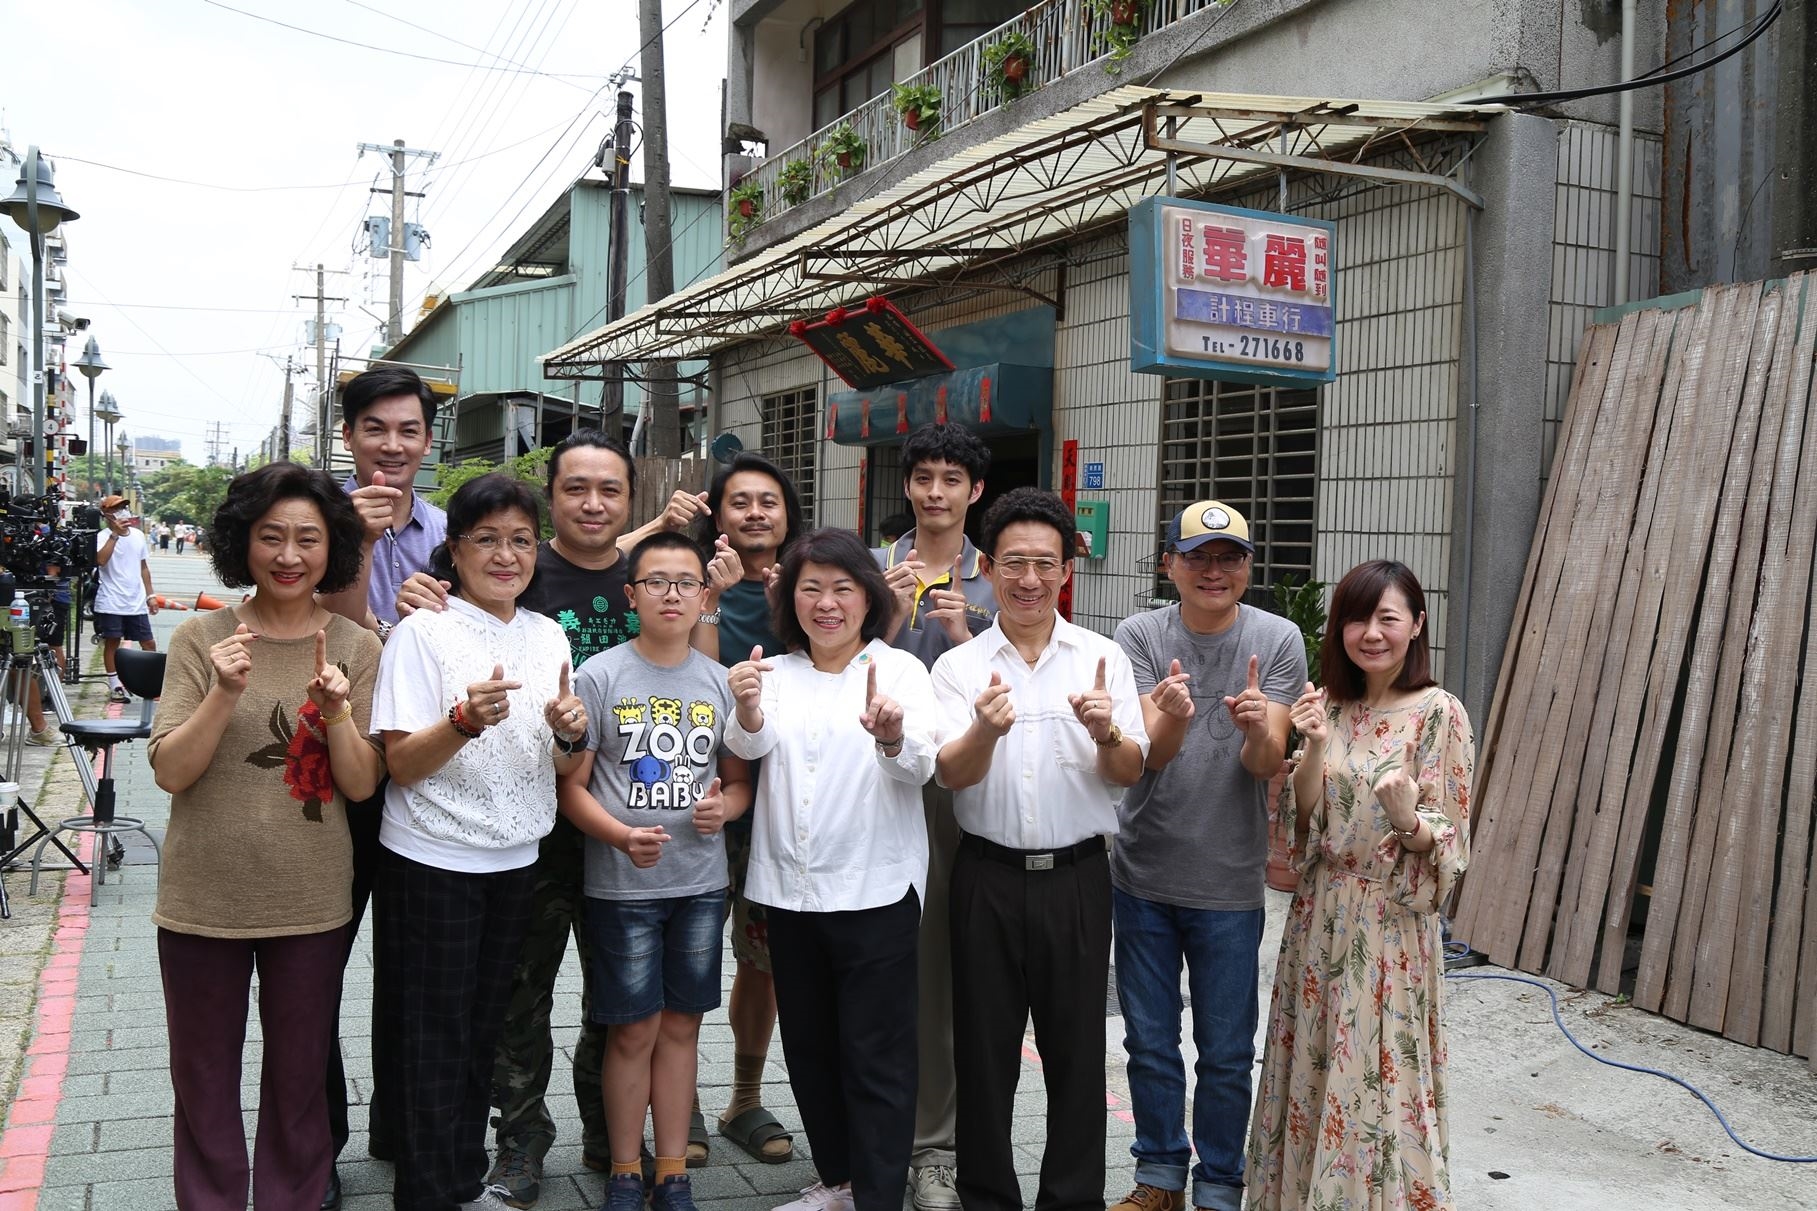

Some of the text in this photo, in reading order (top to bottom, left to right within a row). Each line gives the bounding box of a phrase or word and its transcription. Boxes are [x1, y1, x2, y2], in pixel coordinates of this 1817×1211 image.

[1181, 218, 1194, 280] 日夜服務
[1203, 224, 1307, 292] 華麗
[1314, 236, 1328, 297] 隨叫隨到
[1209, 295, 1301, 331] 計程車行
[1088, 475, 1101, 486] 798
[618, 721, 716, 768] ZOO
[627, 781, 706, 810] BABY
